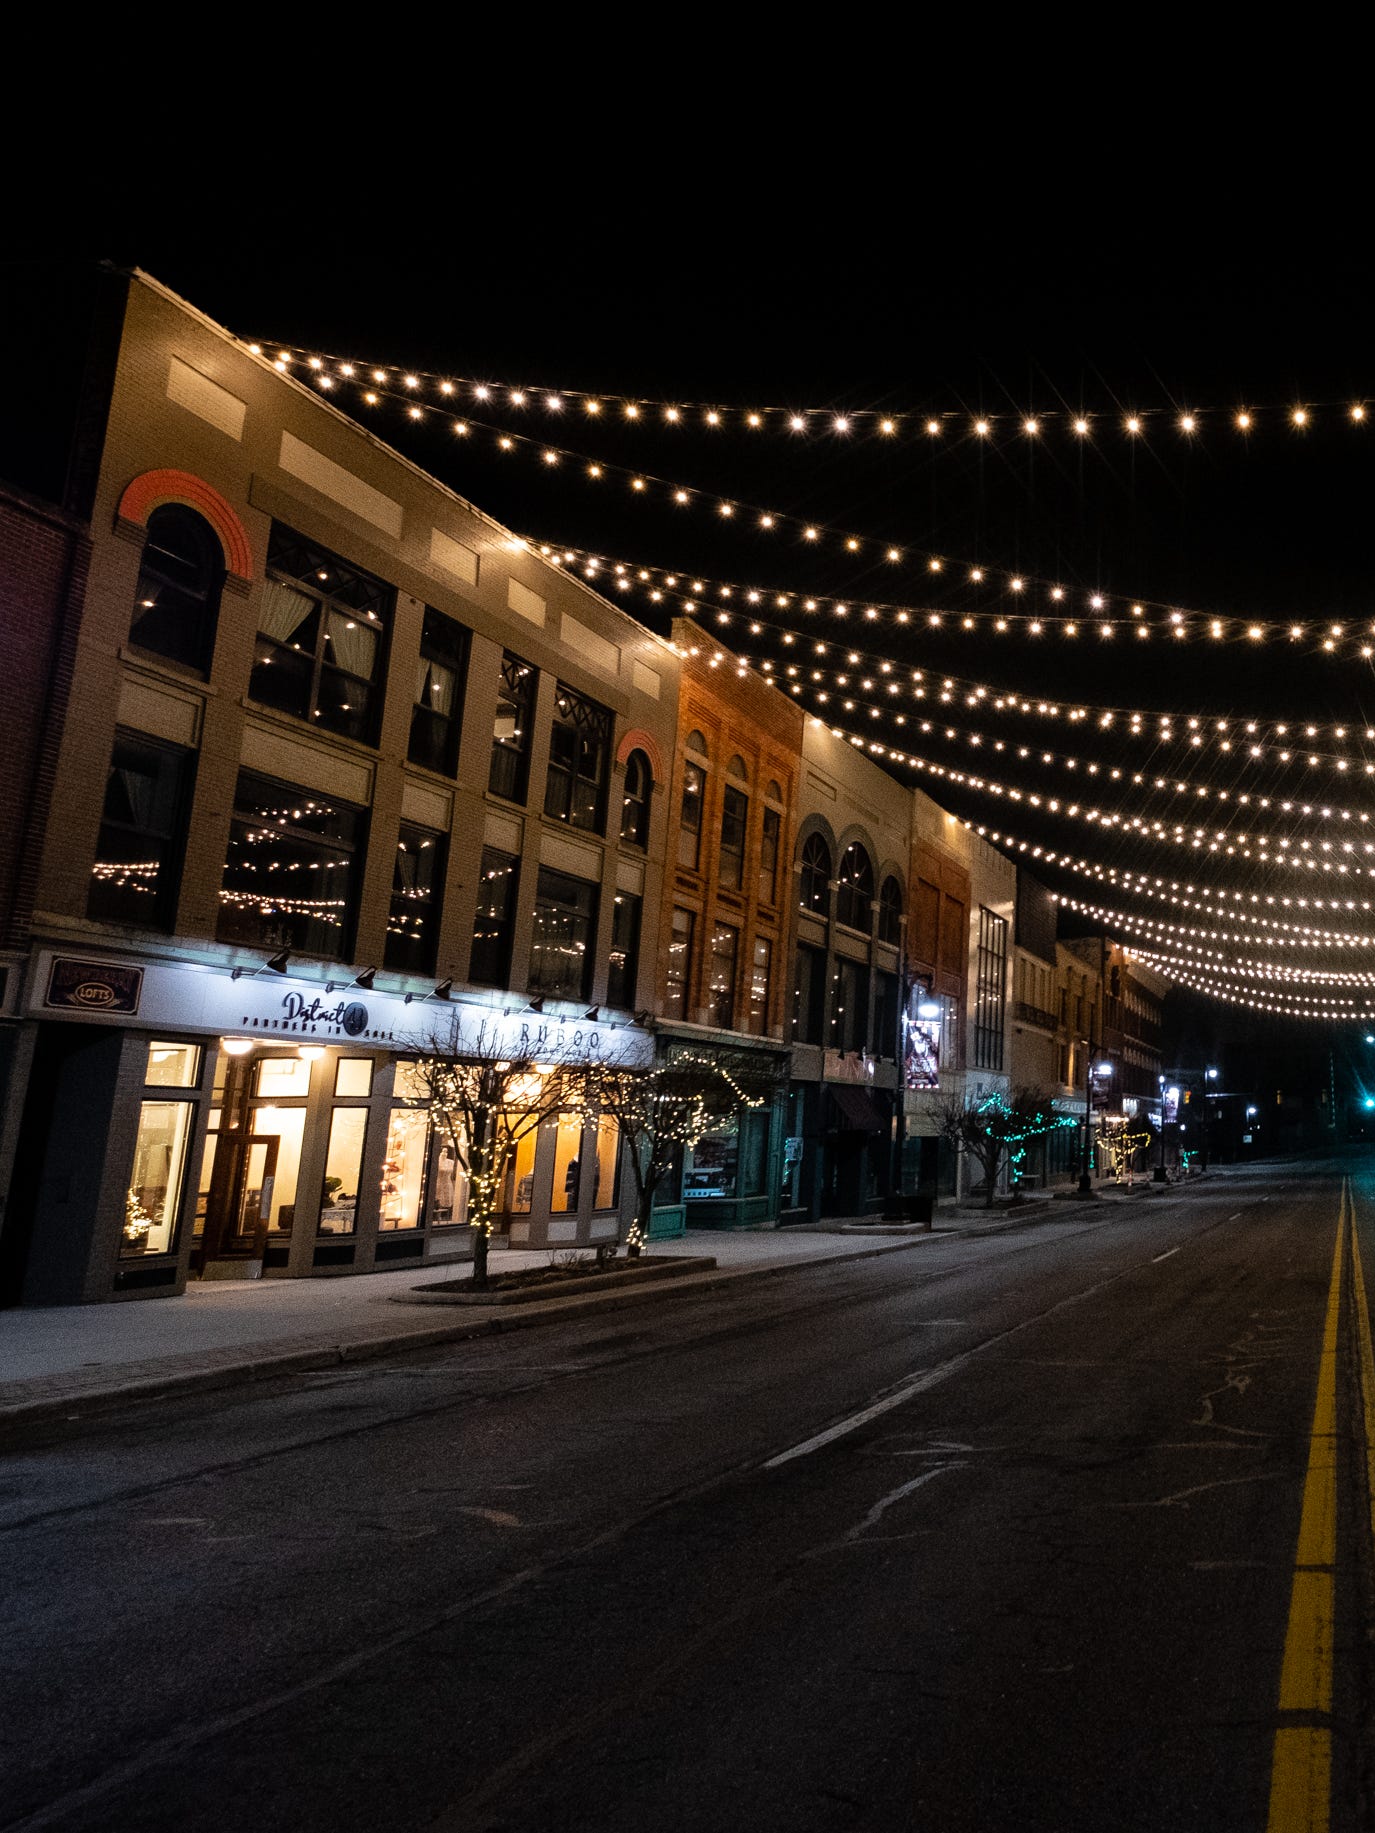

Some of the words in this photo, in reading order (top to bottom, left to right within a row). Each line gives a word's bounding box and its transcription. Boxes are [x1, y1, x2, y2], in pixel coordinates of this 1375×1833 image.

[80, 986, 111, 1000] LOFTS
[282, 991, 346, 1026] District
[242, 1016, 317, 1033] PARTNERS
